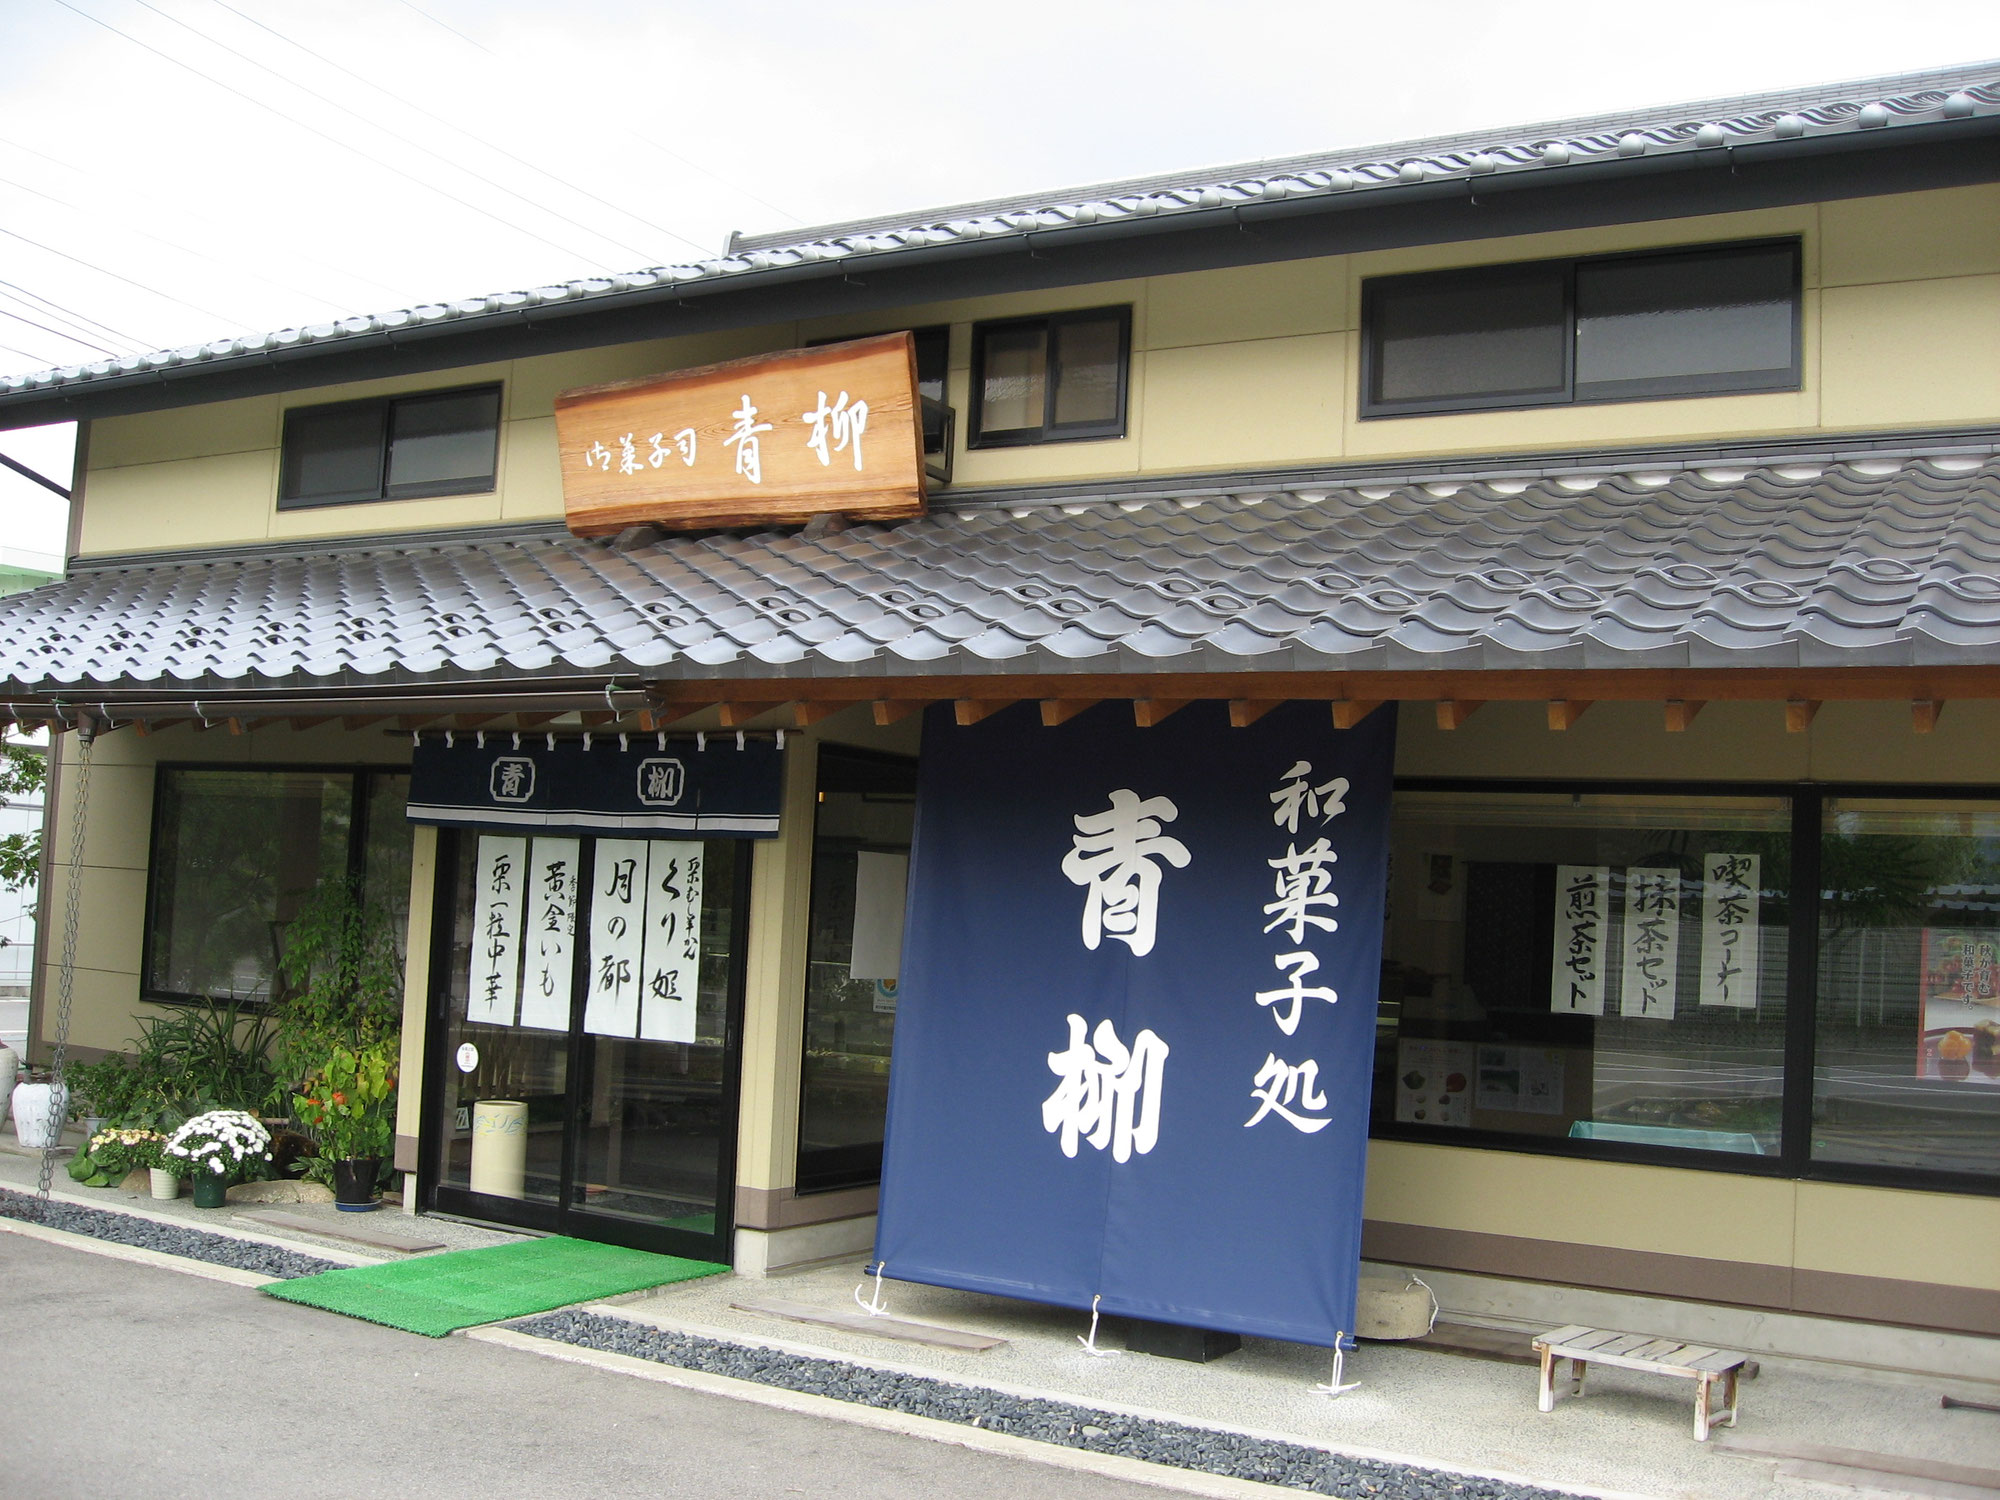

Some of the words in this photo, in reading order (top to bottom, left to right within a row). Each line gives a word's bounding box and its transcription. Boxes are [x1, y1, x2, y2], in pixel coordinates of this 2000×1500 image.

[722, 390, 870, 484] 青柳
[501, 763, 526, 796] 青
[647, 765, 675, 799] 柳
[540, 861, 567, 997] 黄金いも
[597, 858, 637, 1008] 月の都
[648, 858, 682, 1002] くり姫
[1042, 788, 1192, 1164] 青柳
[1243, 760, 1350, 1133] 和菓子処
[1565, 873, 1602, 1009] 煎茶セット
[1632, 874, 1677, 1015] 抹茶セット
[1711, 855, 1751, 1002] 喫茶コーナー
